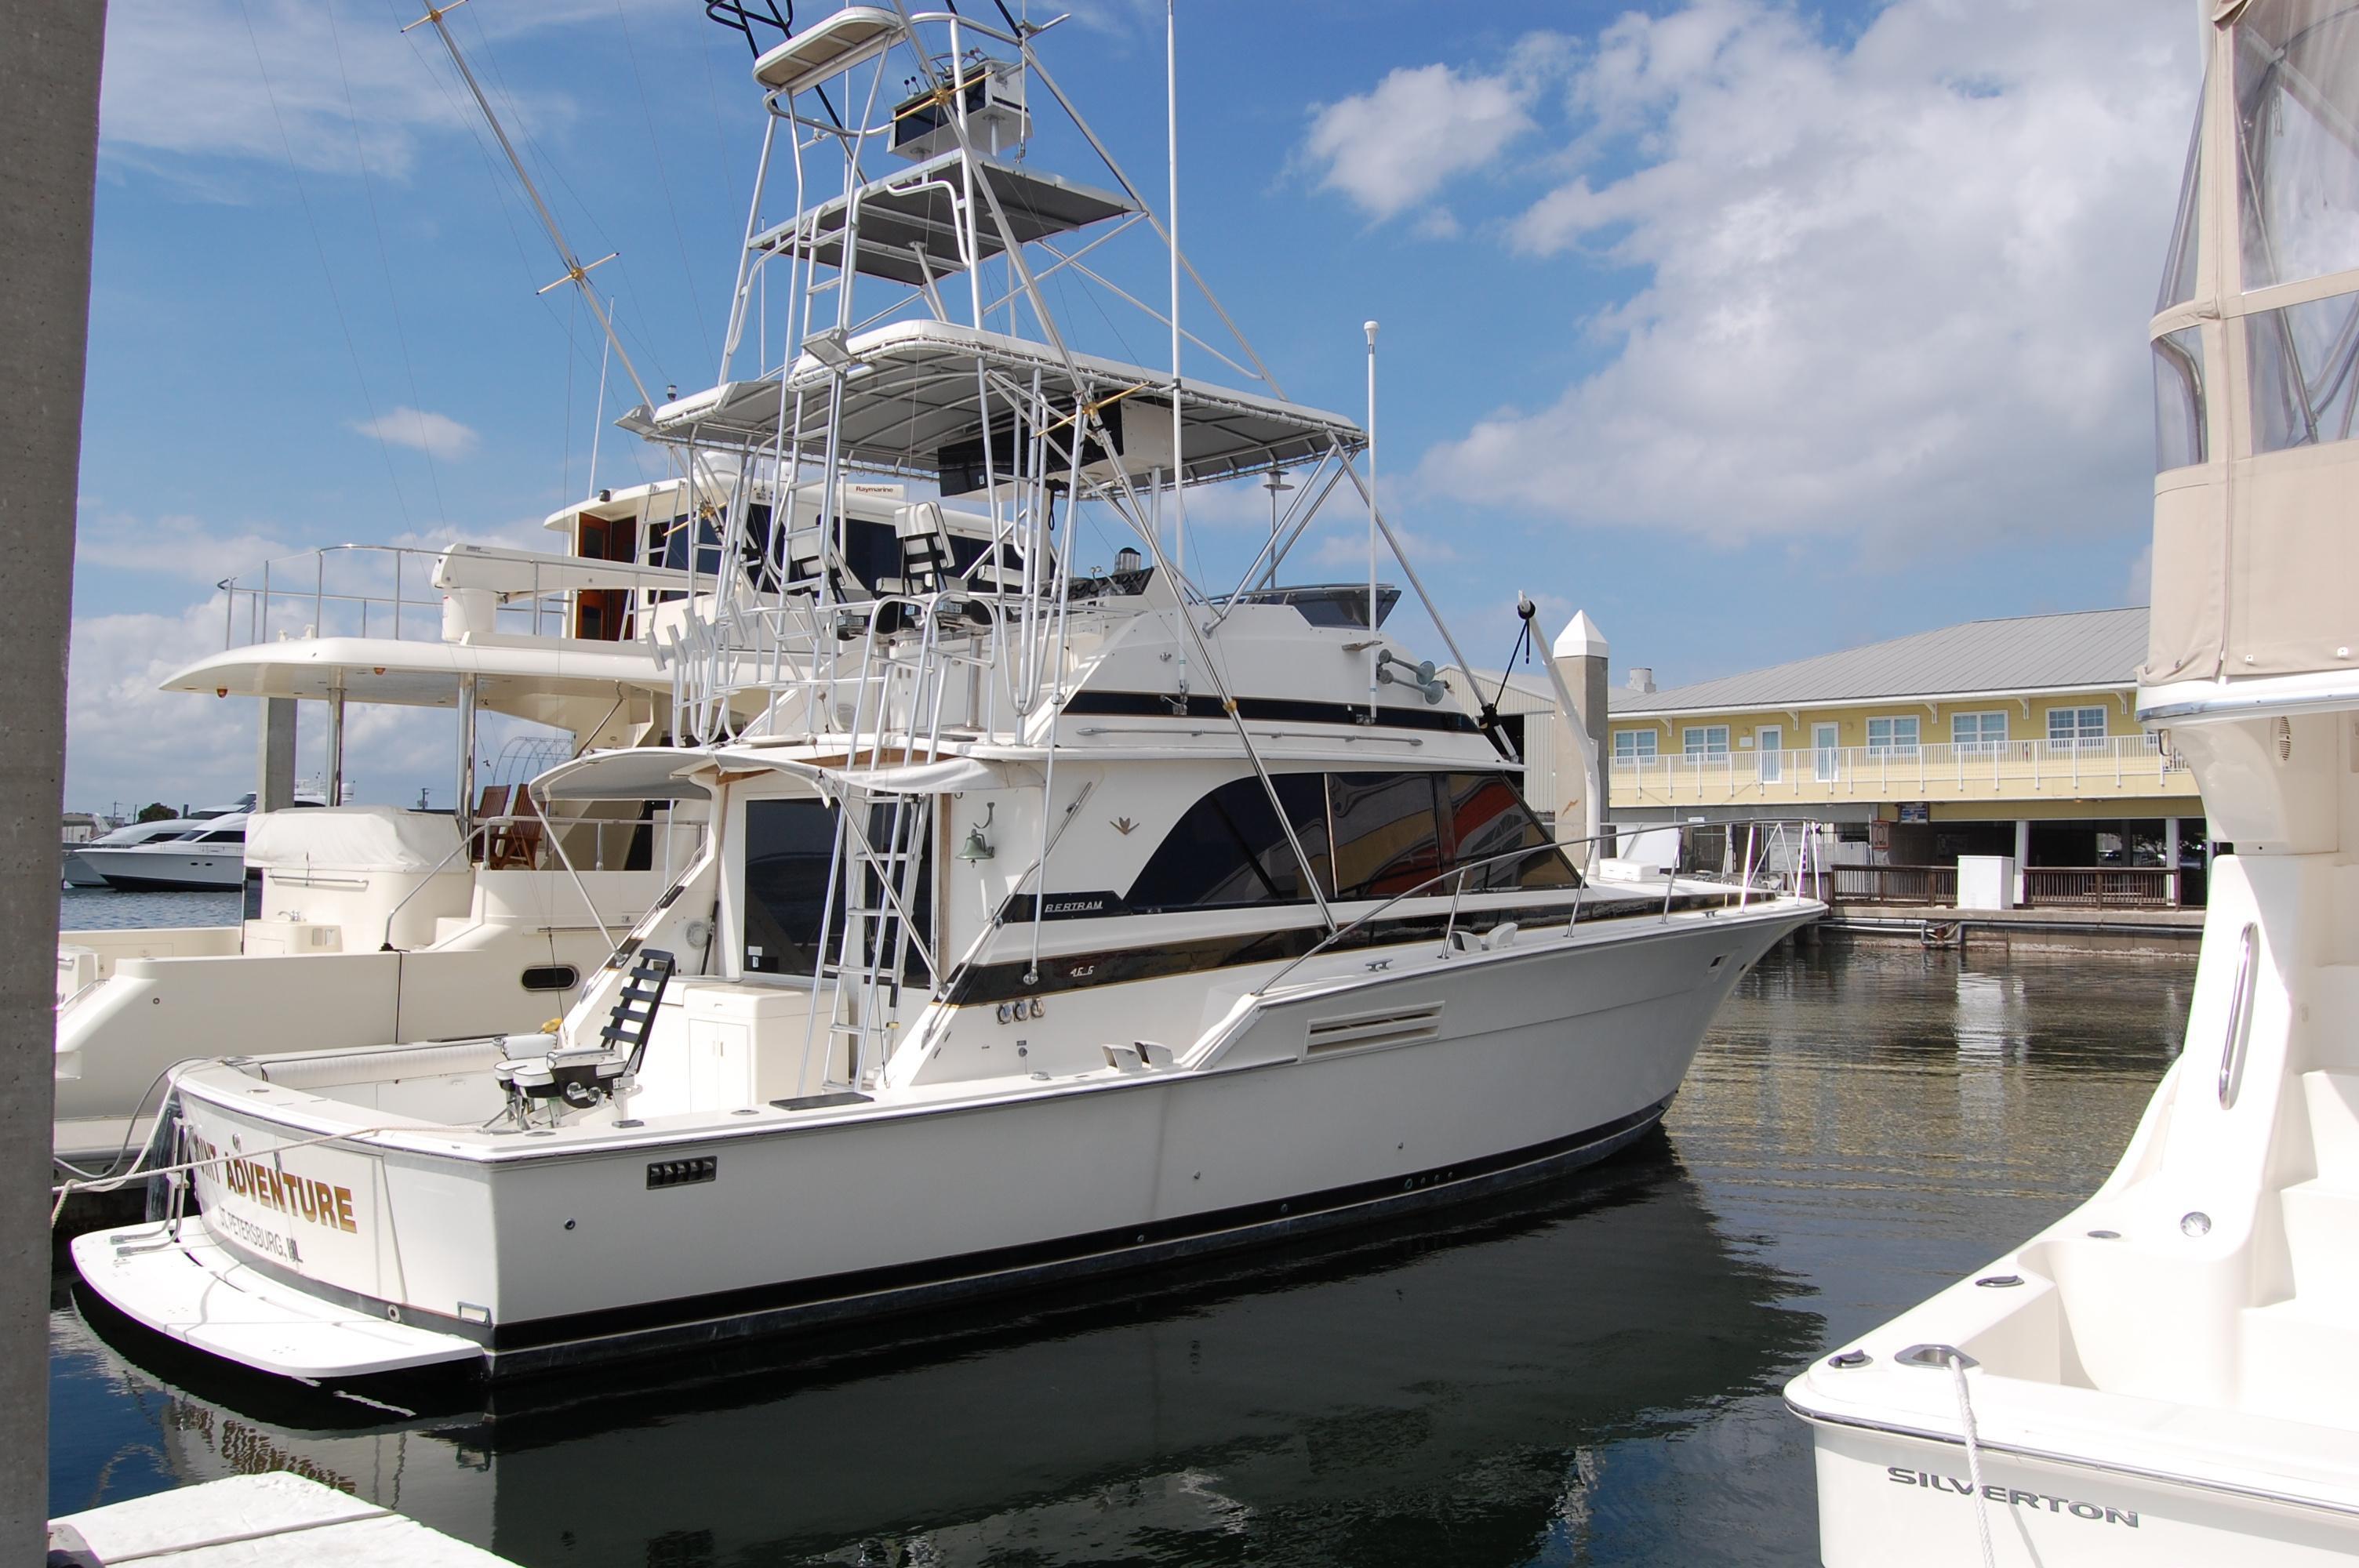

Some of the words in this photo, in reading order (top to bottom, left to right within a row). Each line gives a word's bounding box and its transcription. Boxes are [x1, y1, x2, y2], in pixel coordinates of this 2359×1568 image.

[1044, 900, 1103, 913] BERTRAM
[224, 1151, 358, 1235] ADVENTURE
[1887, 1466, 2139, 1529] SILVERTON
